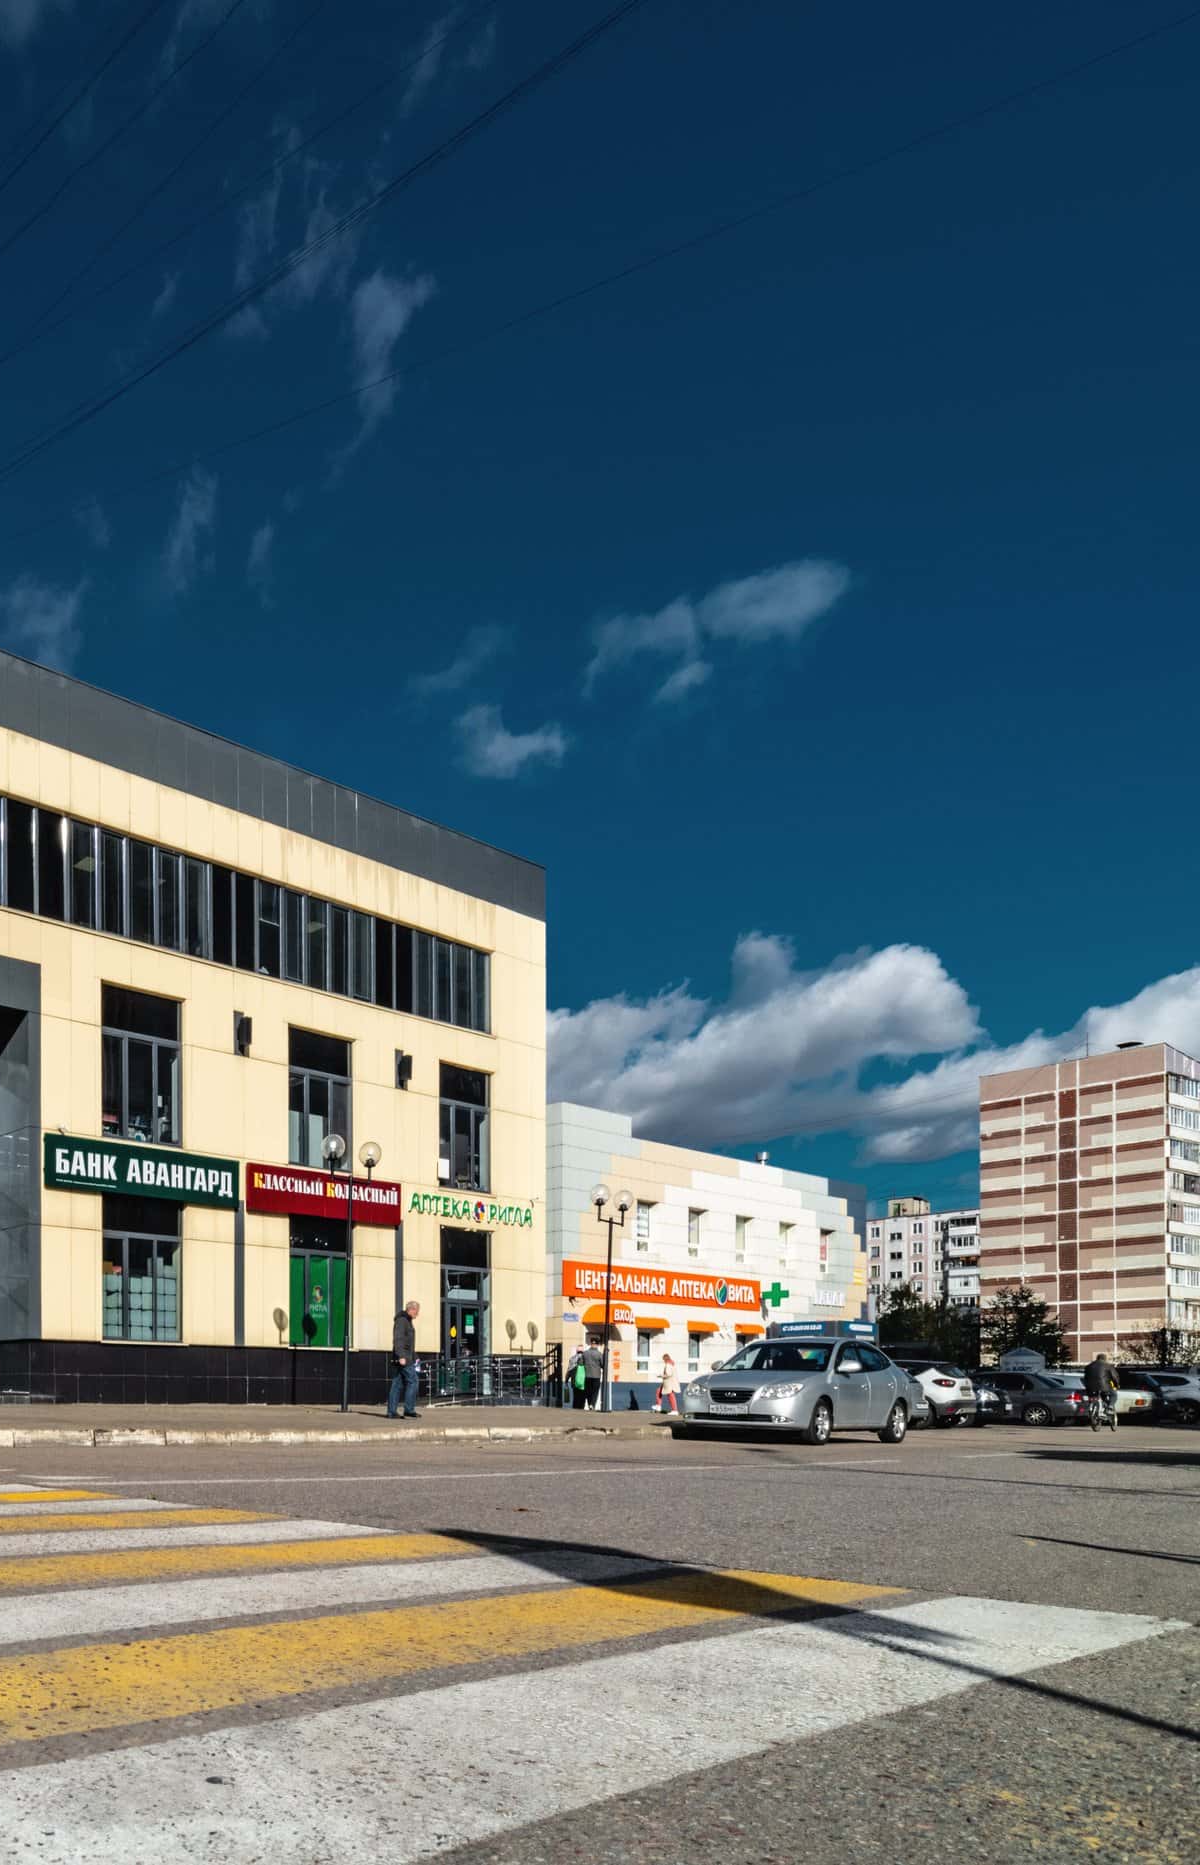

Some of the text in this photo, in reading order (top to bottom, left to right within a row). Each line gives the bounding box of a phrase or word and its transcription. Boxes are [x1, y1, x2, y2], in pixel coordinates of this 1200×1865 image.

[55, 1148, 233, 1198] БАНК АВАНГАРД
[253, 1172, 398, 1206] КЛАССНЫЙ КОЛБАСНЫЙ
[408, 1192, 533, 1228] АПТЕКА РИГЛА
[575, 1269, 756, 1304] ЦЕНТРАЛЬНАЯ АПТЕКА ВИТА
[613, 1308, 636, 1323] ВХОД
